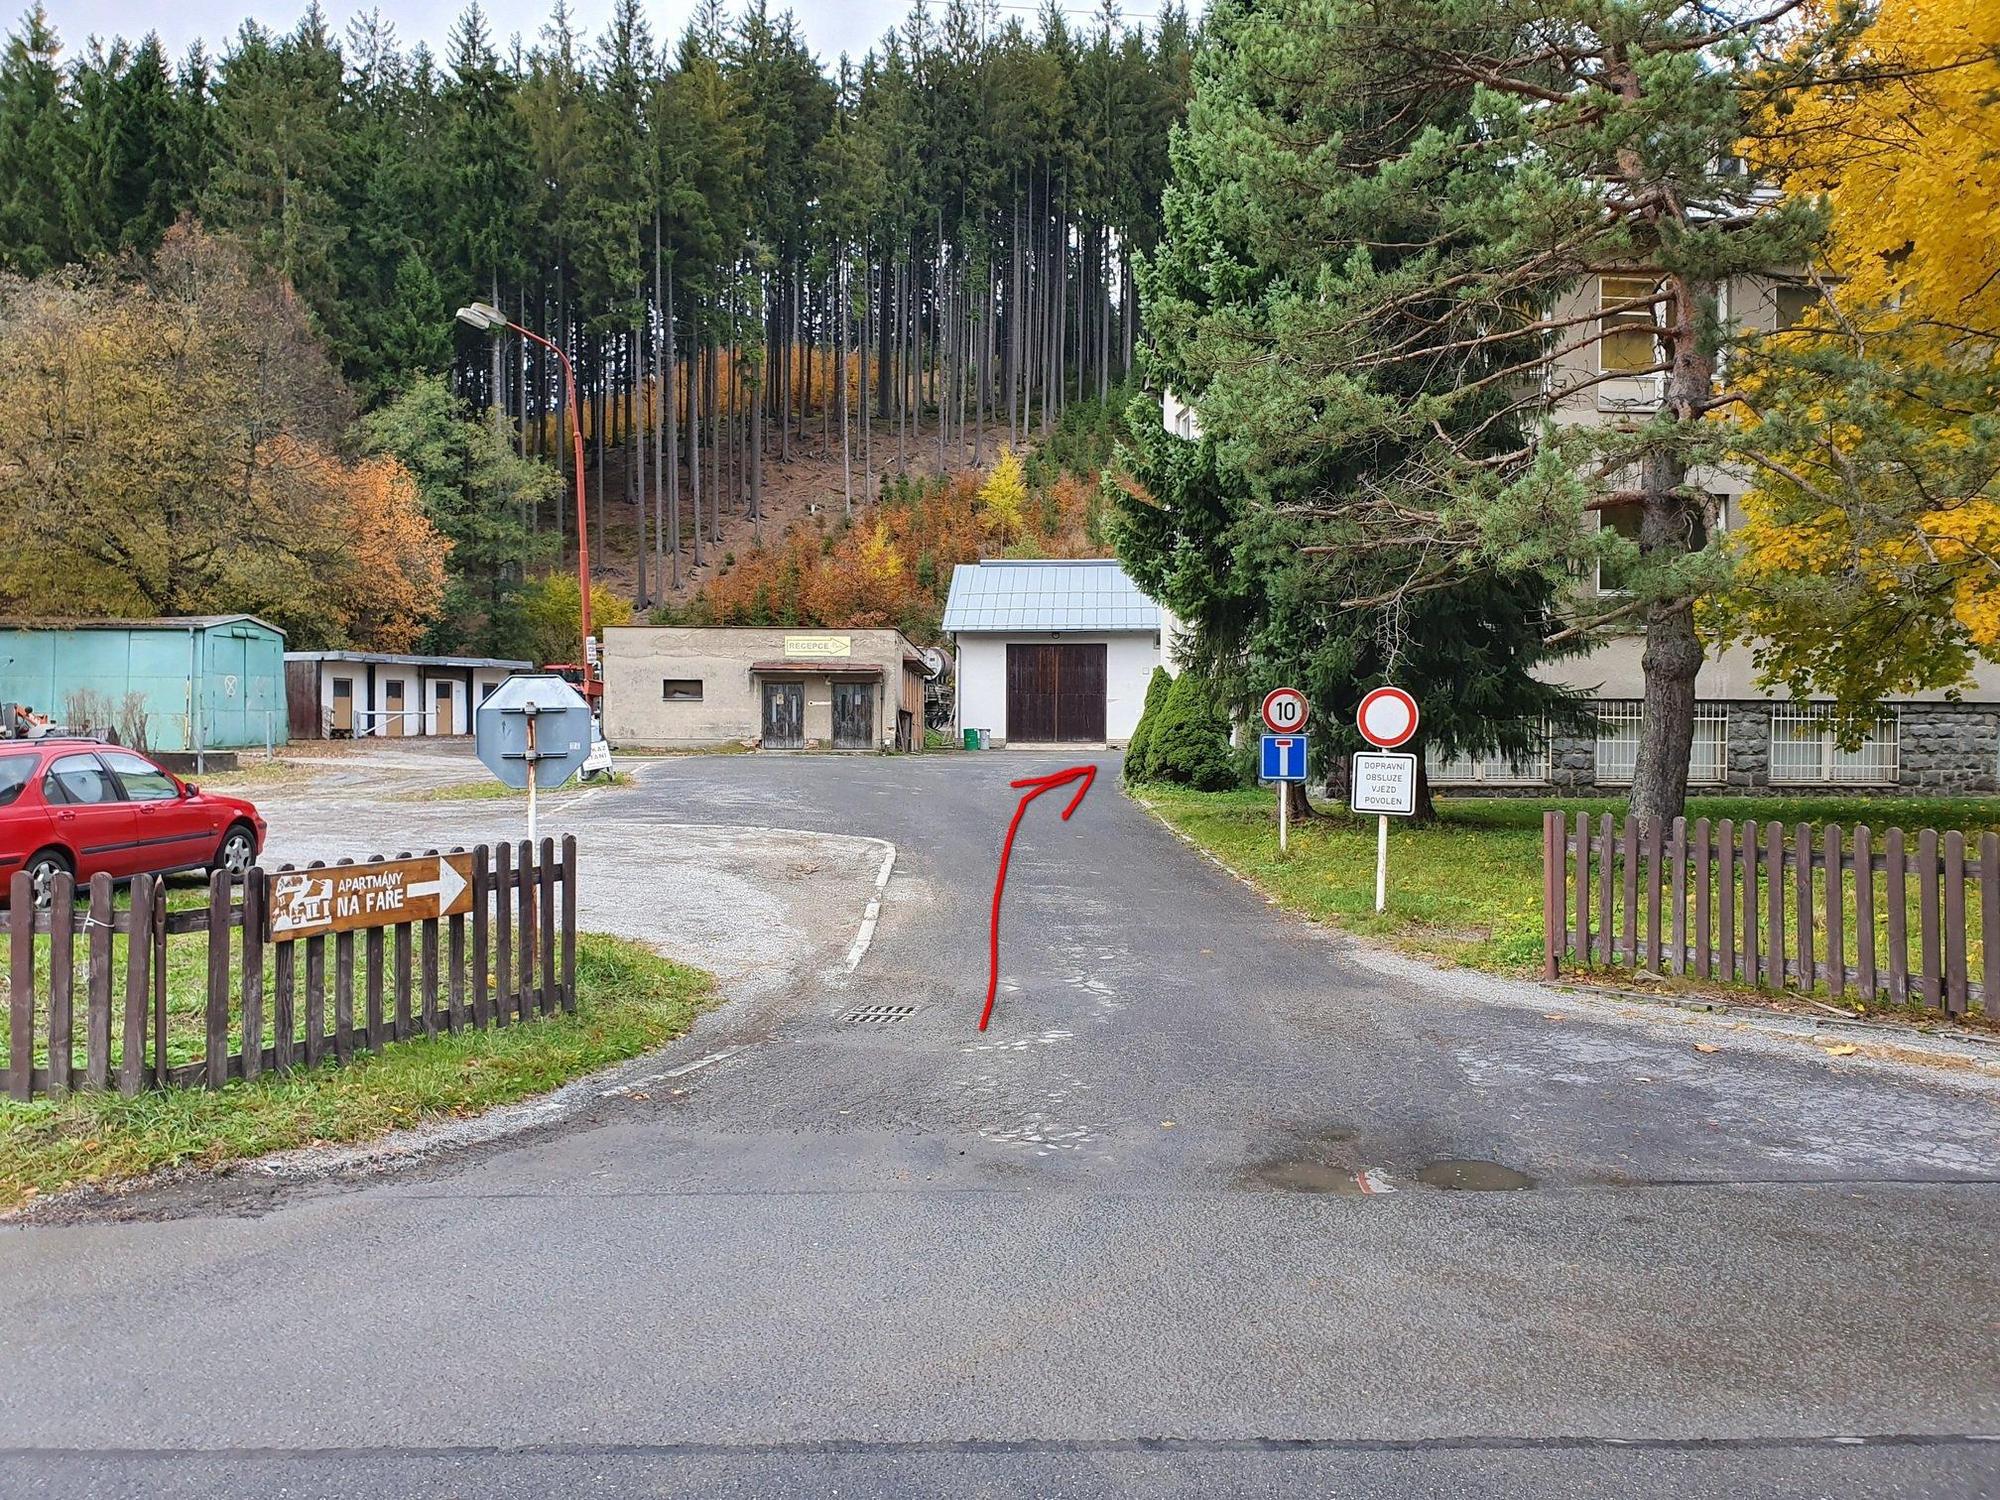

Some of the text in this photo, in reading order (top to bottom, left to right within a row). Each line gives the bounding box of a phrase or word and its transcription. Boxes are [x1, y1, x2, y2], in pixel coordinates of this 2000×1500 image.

[789, 642, 831, 650] RECEPCE
[1275, 702, 1296, 721] 10
[1364, 761, 1406, 770] DOPRAVNÍ
[1365, 773, 1403, 783] OBSLUZE
[1371, 785, 1397, 793] VJEZD
[1364, 796, 1402, 805] POVOLEN
[337, 870, 405, 893] APARTMÁNY
[337, 886, 404, 917] NA FAŘE
